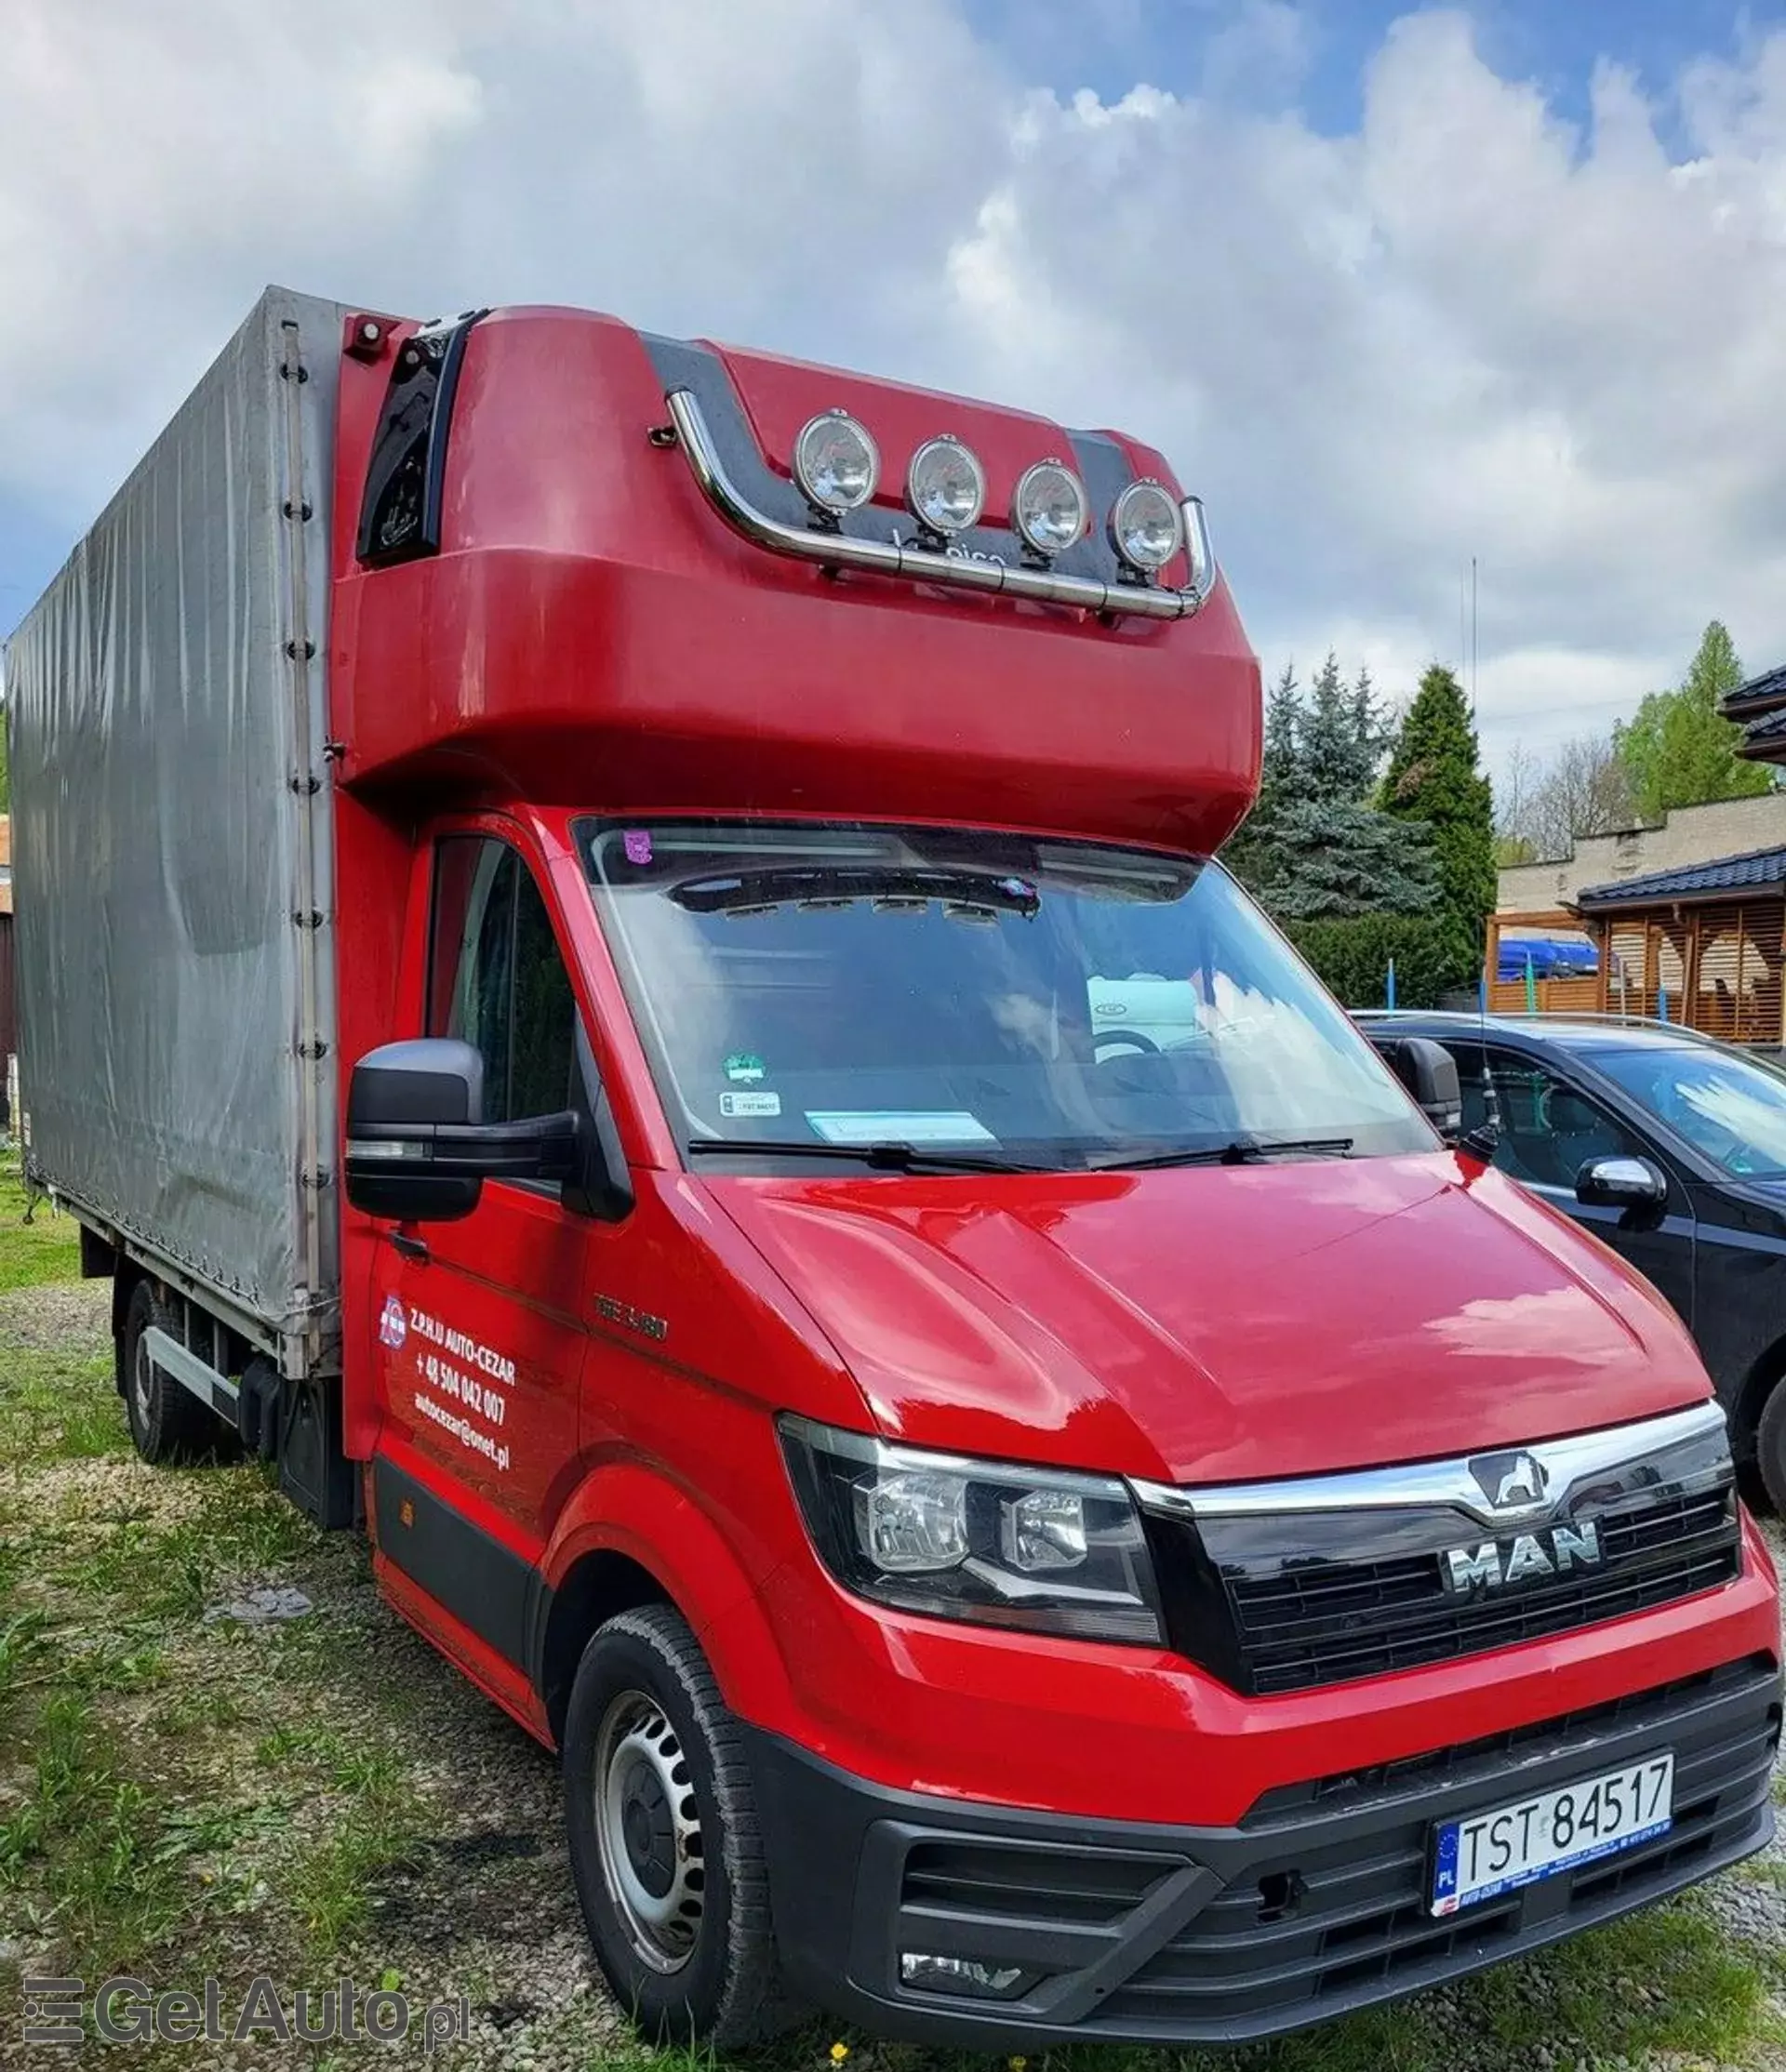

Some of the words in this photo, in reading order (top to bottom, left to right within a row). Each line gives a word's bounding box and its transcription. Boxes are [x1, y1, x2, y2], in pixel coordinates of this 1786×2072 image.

[416, 1352, 424, 1375] +
[426, 1355, 438, 1386] 48
[440, 1362, 459, 1398] 504
[461, 1375, 482, 1414] 042
[484, 1389, 505, 1427] 007
[445, 1328, 515, 1387] AUTO-CEZAR
[415, 1392, 510, 1472] autocezar@onet.pl
[1446, 1521, 1603, 1594] MAN
[1463, 1803, 1539, 1882] TST
[1552, 1760, 1669, 1849] 84517
[1437, 1868, 1455, 1890] PL
